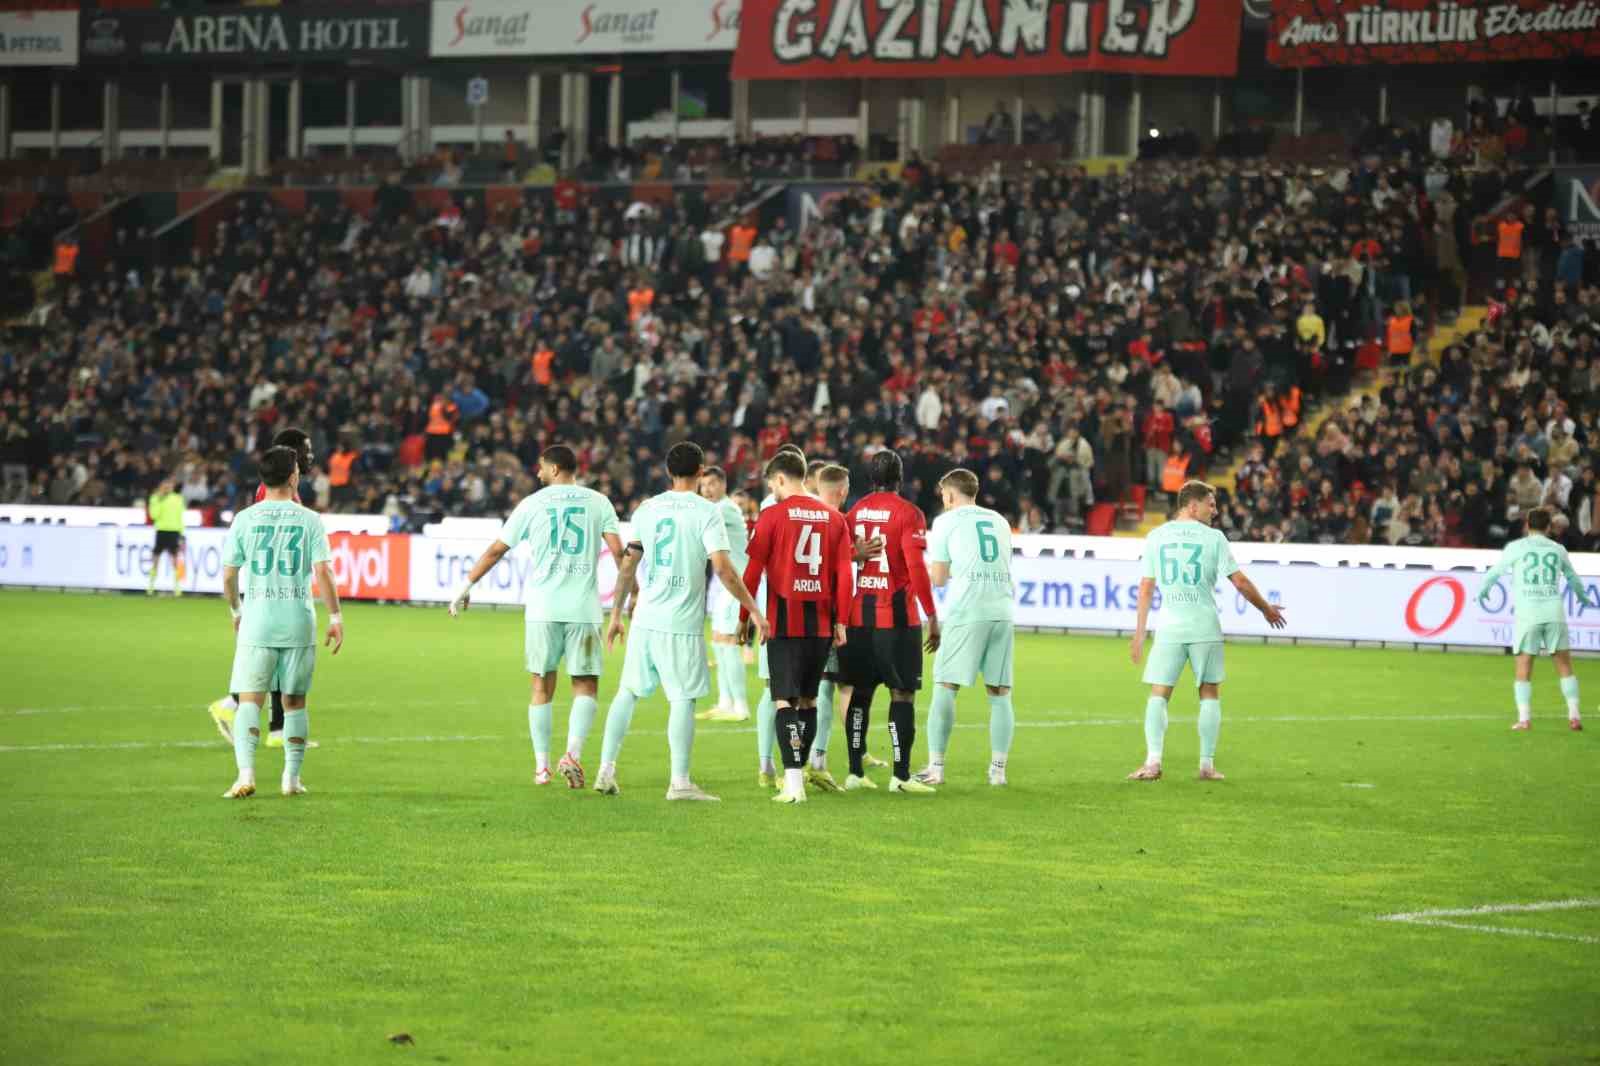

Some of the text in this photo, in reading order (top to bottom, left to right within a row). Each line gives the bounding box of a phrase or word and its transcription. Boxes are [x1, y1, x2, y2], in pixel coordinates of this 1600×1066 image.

[166, 14, 288, 53] ARENA
[300, 19, 408, 49] HOTEL
[1279, 17, 1338, 46] Ama
[1345, 4, 1478, 44] TÜRKLÜK
[251, 525, 304, 577] 33
[546, 506, 585, 555] 15
[655, 517, 676, 567] 2
[794, 524, 823, 576] 4
[976, 521, 999, 562] 6
[793, 579, 822, 592] ARDA
[1160, 543, 1203, 586] 63
[1522, 551, 1559, 585] 28
